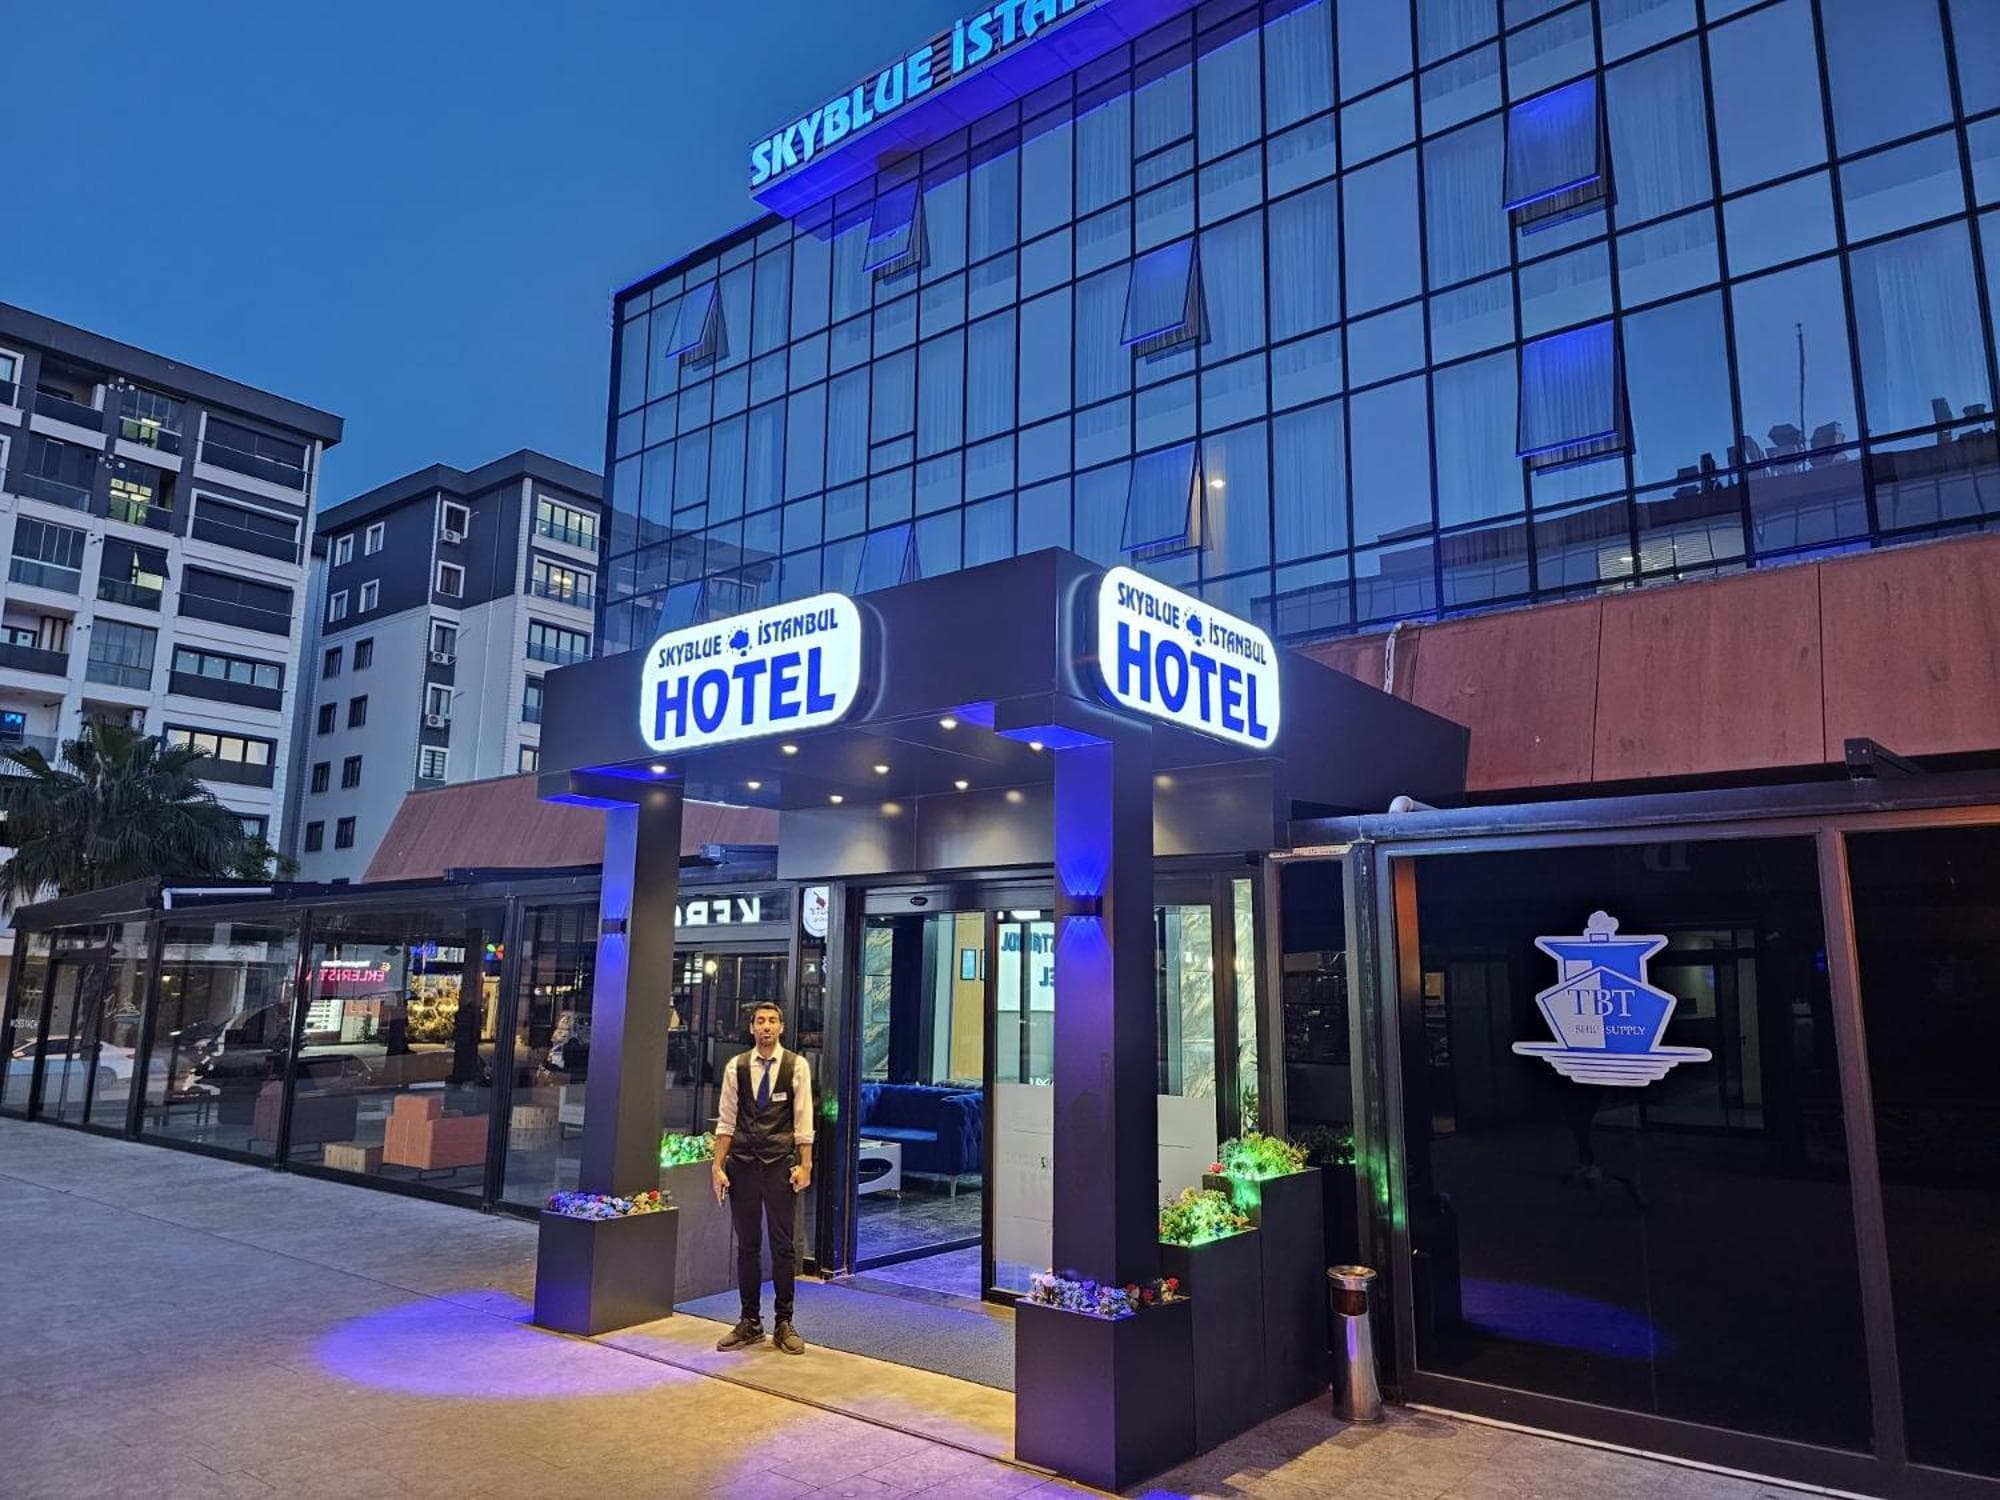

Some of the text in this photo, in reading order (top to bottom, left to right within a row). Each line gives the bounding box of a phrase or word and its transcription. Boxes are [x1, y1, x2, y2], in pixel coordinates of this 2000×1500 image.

[751, 0, 1076, 187] SKYBLUE İSTA
[658, 607, 839, 668] SKYBLUE İSTANBUL
[1118, 582, 1267, 666] SKYBLUE İSTANBUL
[654, 646, 837, 741] HOTEL
[1117, 620, 1268, 742] HOTEL
[1567, 989, 1636, 1017] TBT
[1605, 1025, 1646, 1036] SUPPLY
